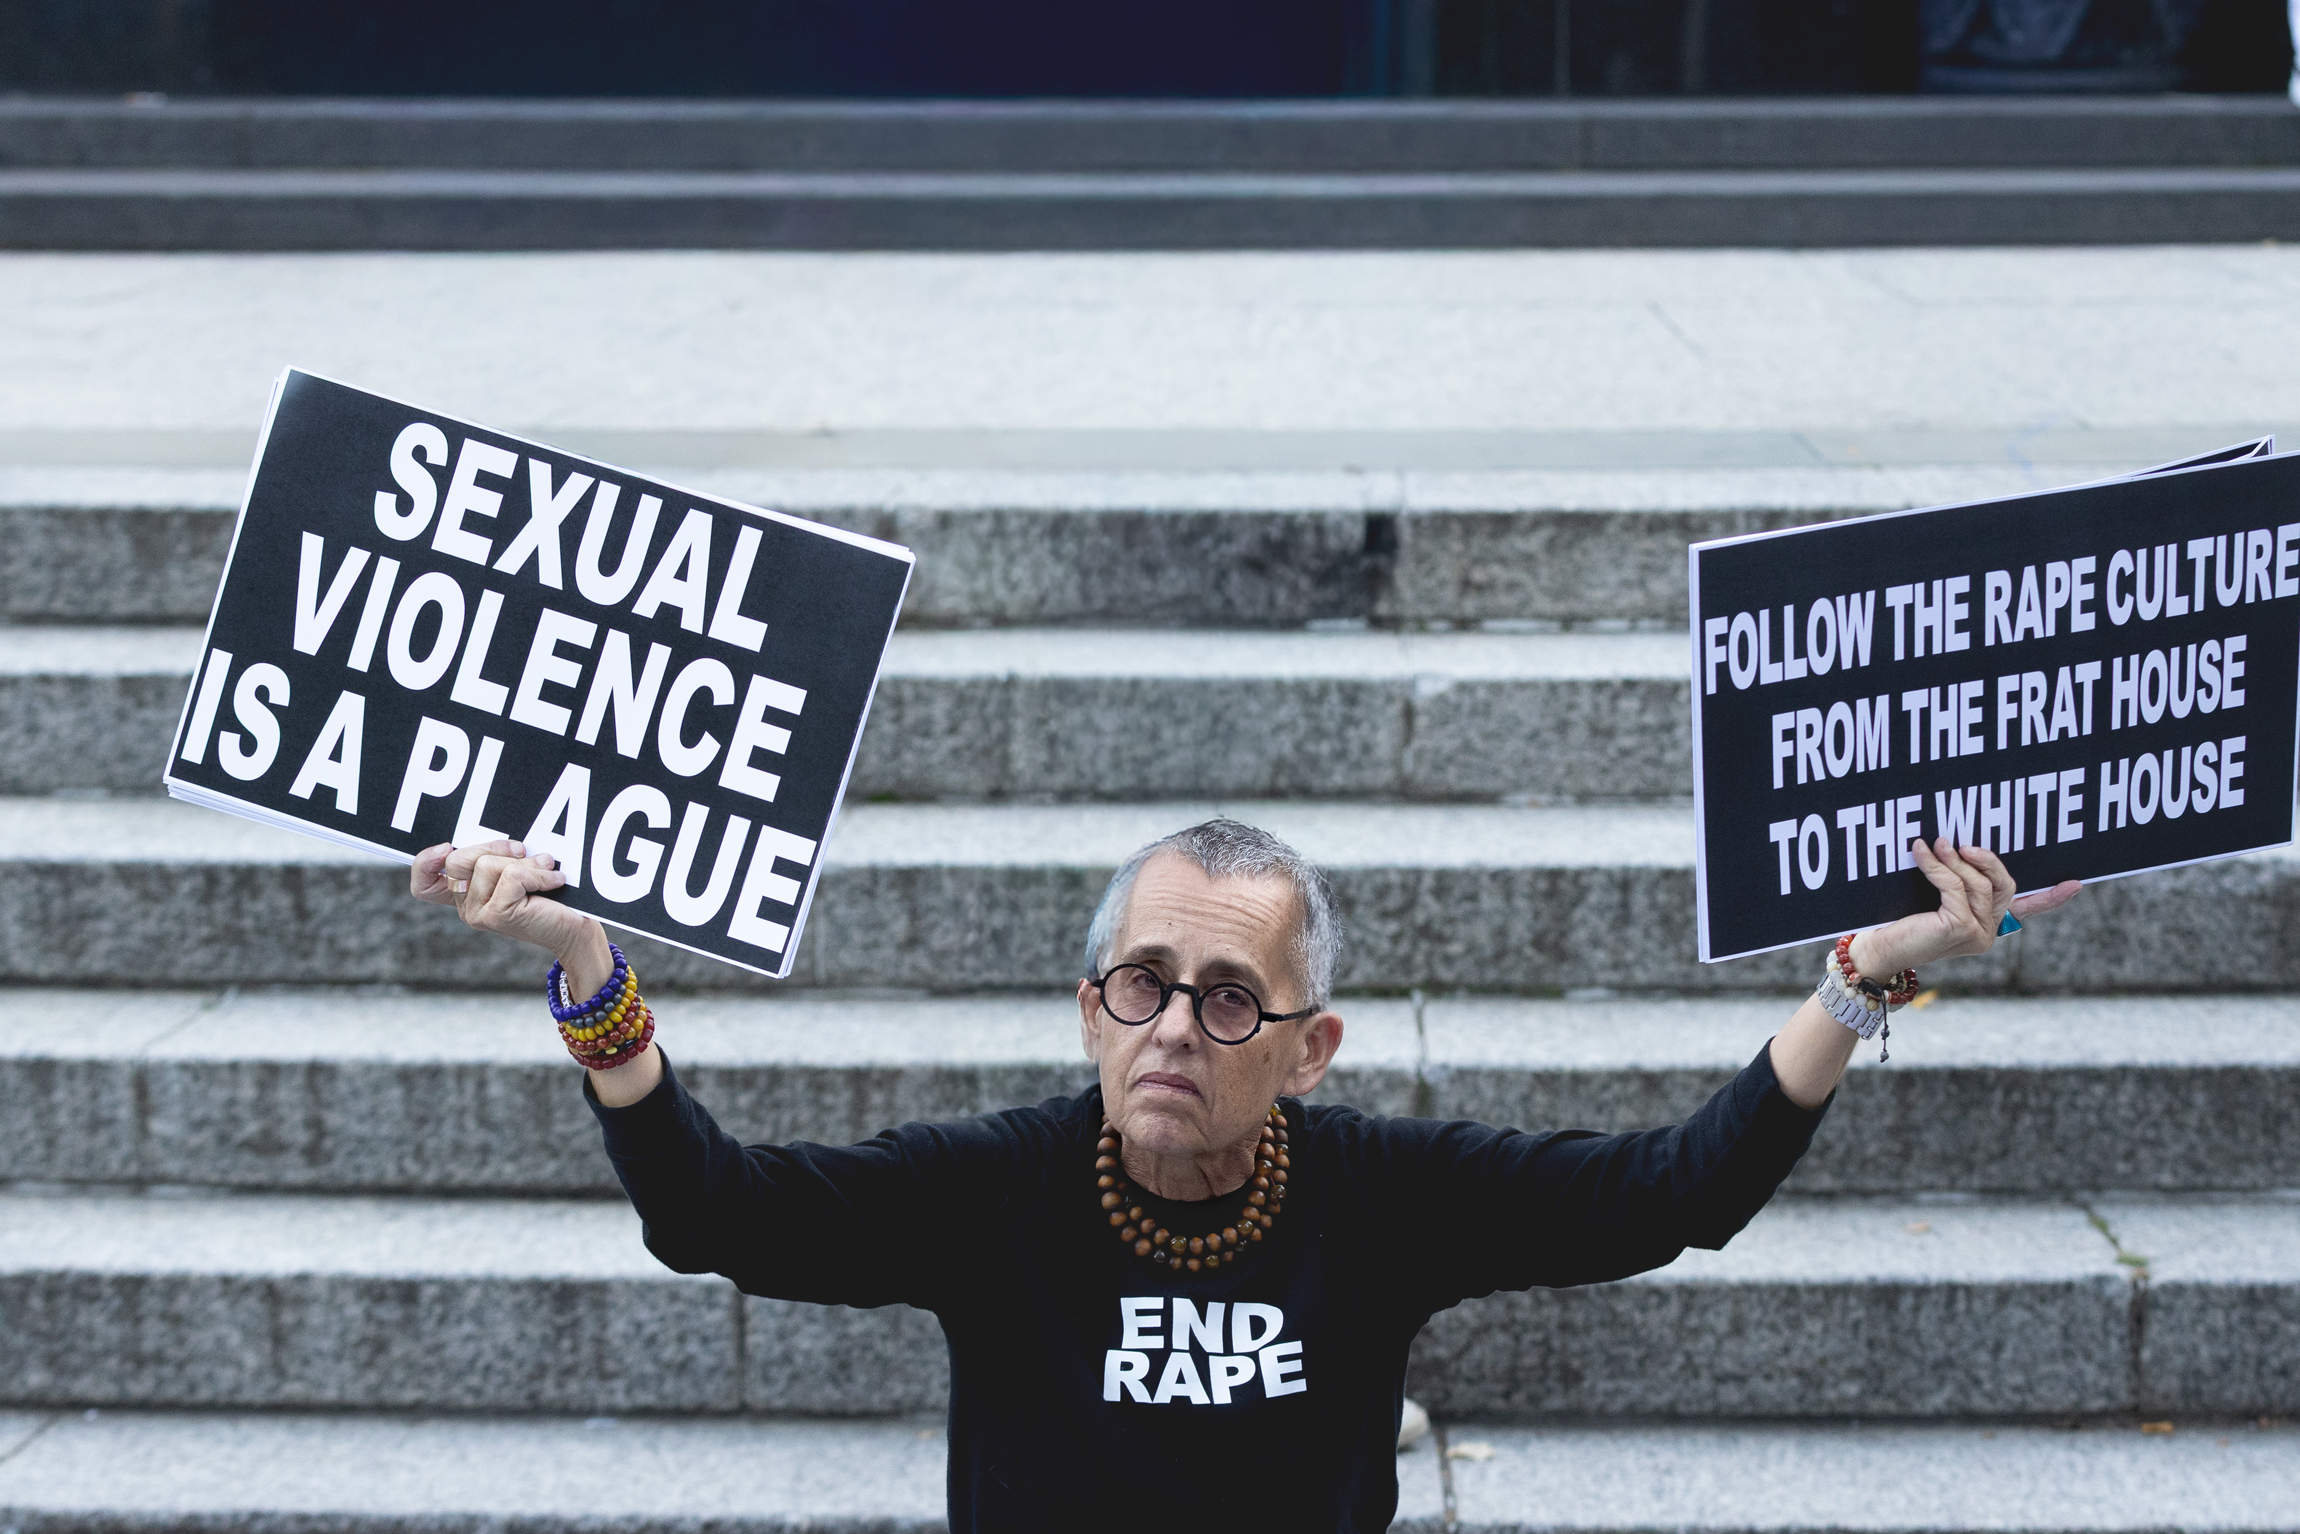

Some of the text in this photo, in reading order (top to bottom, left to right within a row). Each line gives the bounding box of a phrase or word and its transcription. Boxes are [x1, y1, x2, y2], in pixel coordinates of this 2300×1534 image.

[374, 423, 768, 653] SEXUAL
[1706, 523, 2300, 695] FOLLOW THE RAPE CULTURE
[294, 531, 807, 802] VIOLENCE
[1773, 635, 2247, 789] FROM THE FRAT HOUSE
[181, 648, 816, 953] IS A PLAGUE
[1770, 736, 2246, 896] TO THE WHITE HOUSE
[1103, 1340, 1307, 1405] RAPE
[1120, 1297, 1284, 1354] END
